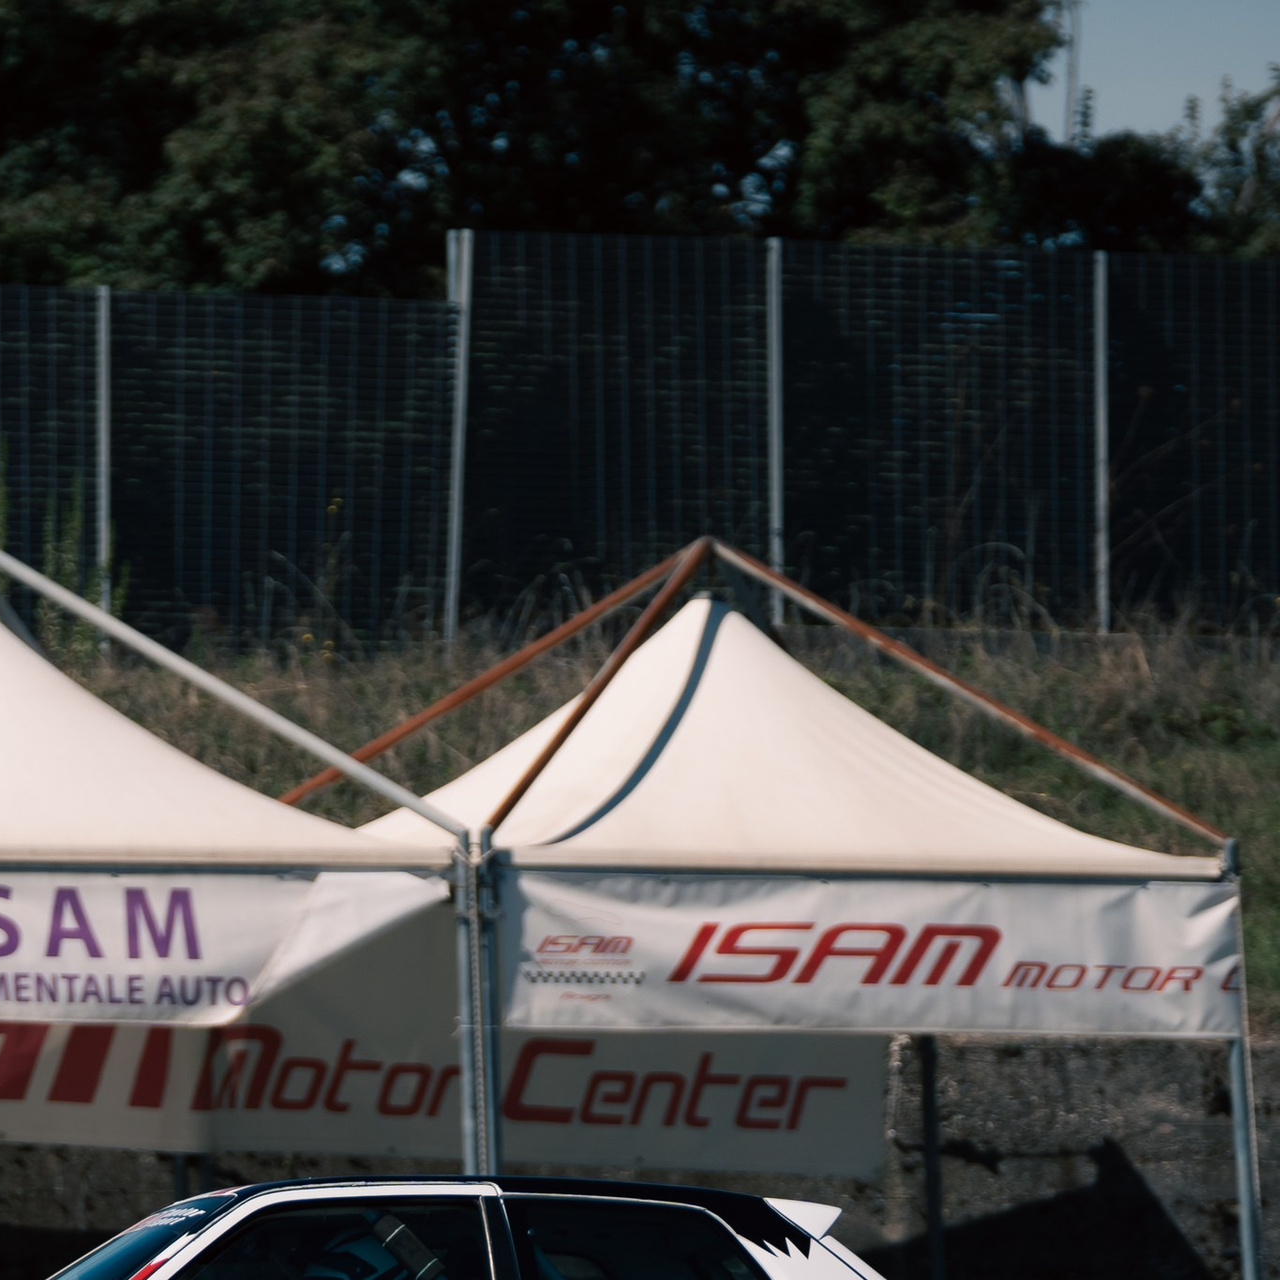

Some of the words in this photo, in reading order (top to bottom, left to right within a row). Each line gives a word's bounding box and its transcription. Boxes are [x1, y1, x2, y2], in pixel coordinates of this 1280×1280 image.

[536, 935, 634, 954] ISAM
[666, 921, 1002, 987] ISAM
[1001, 960, 1204, 993] MOTOR
[155, 974, 250, 1006] AUTO
[500, 1037, 848, 1132] Center
